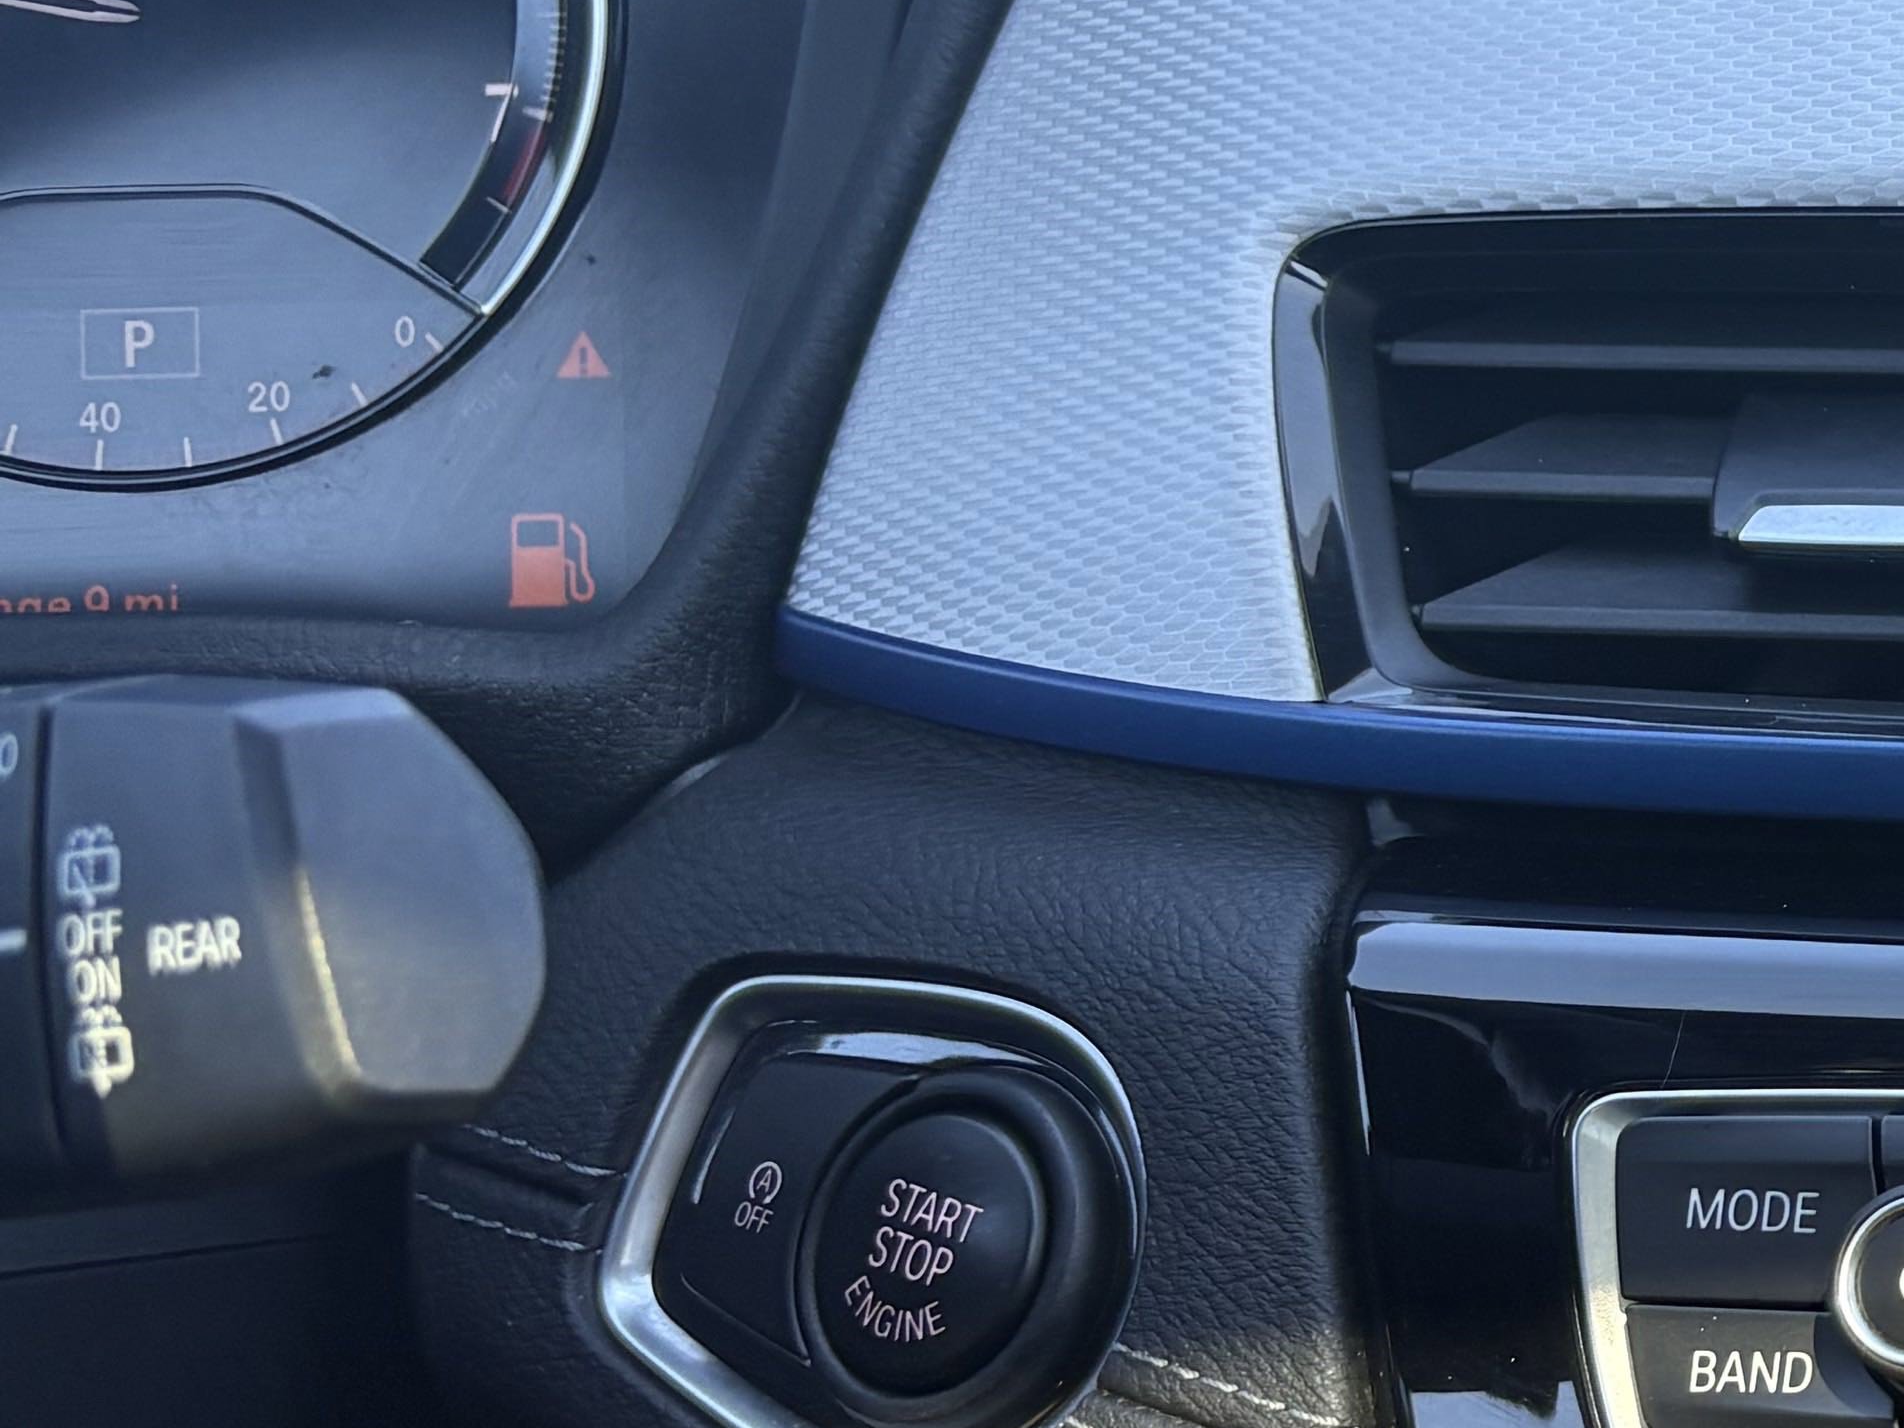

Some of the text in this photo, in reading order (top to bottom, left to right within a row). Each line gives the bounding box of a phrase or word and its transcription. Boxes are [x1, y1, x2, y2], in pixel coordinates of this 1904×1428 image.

[484, 82, 519, 143] 7
[124, 320, 154, 368] P
[394, 316, 417, 348] 0
[79, 401, 121, 433] 40
[247, 380, 291, 413] 20
[58, 908, 124, 958] OFF
[147, 916, 242, 972] REAR
[68, 956, 122, 1006] ON
[734, 1201, 774, 1233] OFF
[880, 1178, 984, 1243] START
[1686, 1187, 1820, 1234] MODE
[867, 1226, 954, 1286] STOP
[843, 1274, 946, 1342] ENGINE
[1689, 1350, 1813, 1394] BAND
